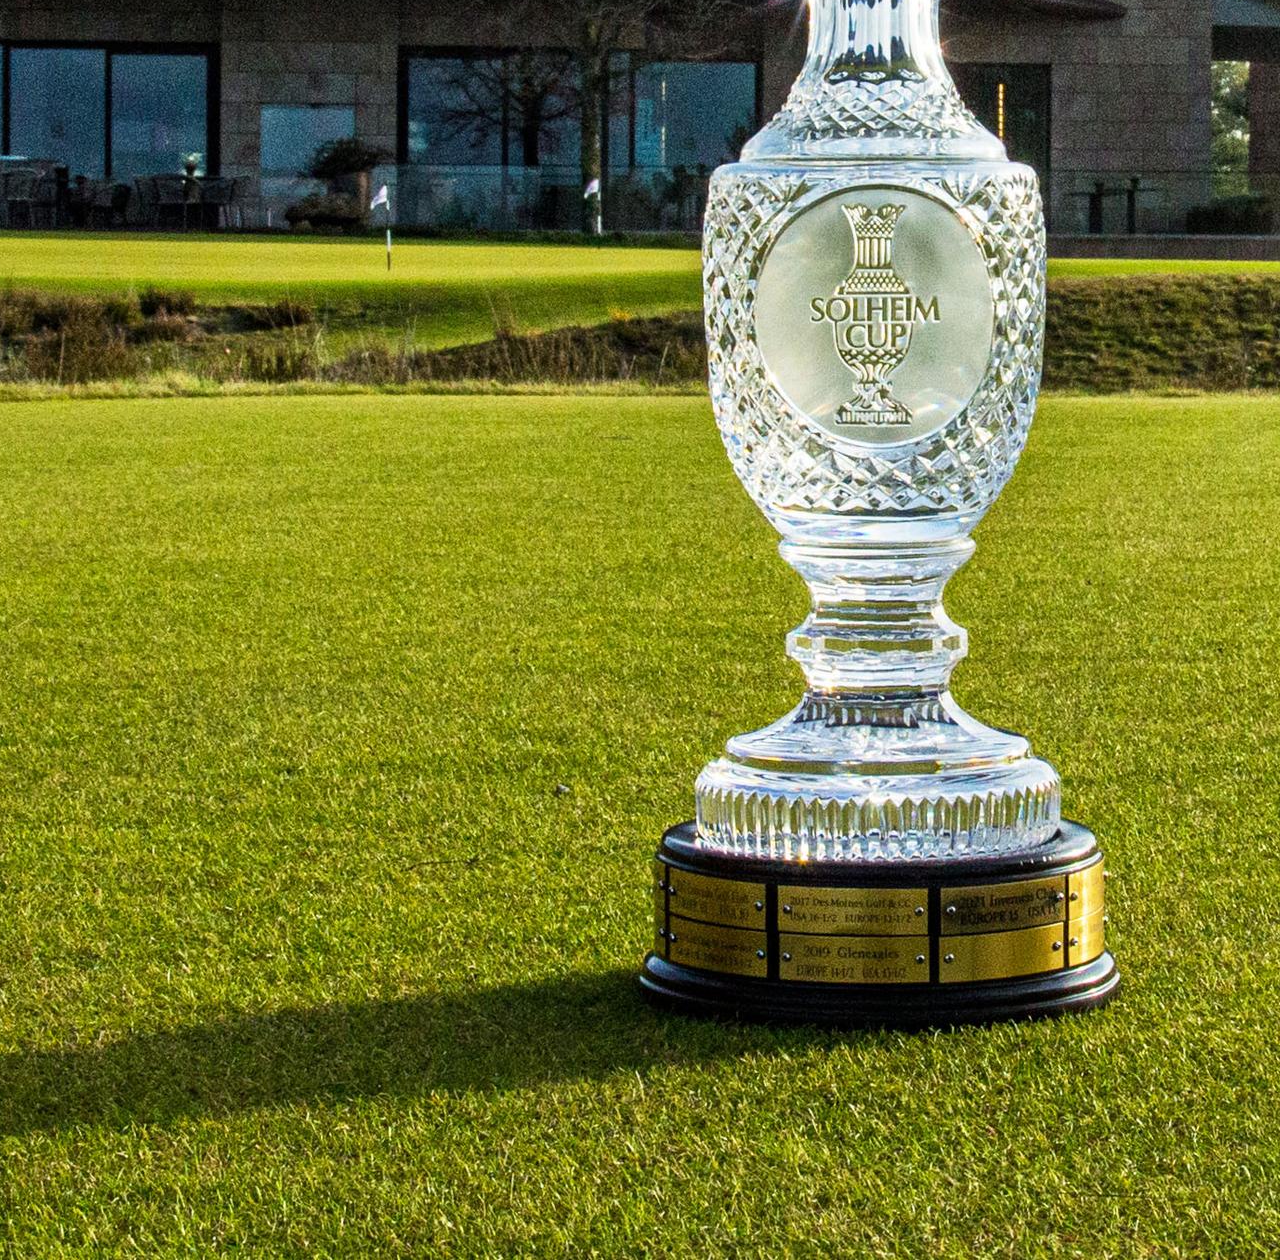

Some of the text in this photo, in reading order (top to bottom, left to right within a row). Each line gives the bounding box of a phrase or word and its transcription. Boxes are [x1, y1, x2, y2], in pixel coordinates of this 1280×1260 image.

[810, 296, 940, 323] SOLHEIM
[845, 324, 908, 349] CUP
[837, 946, 900, 962] Gleneagles
